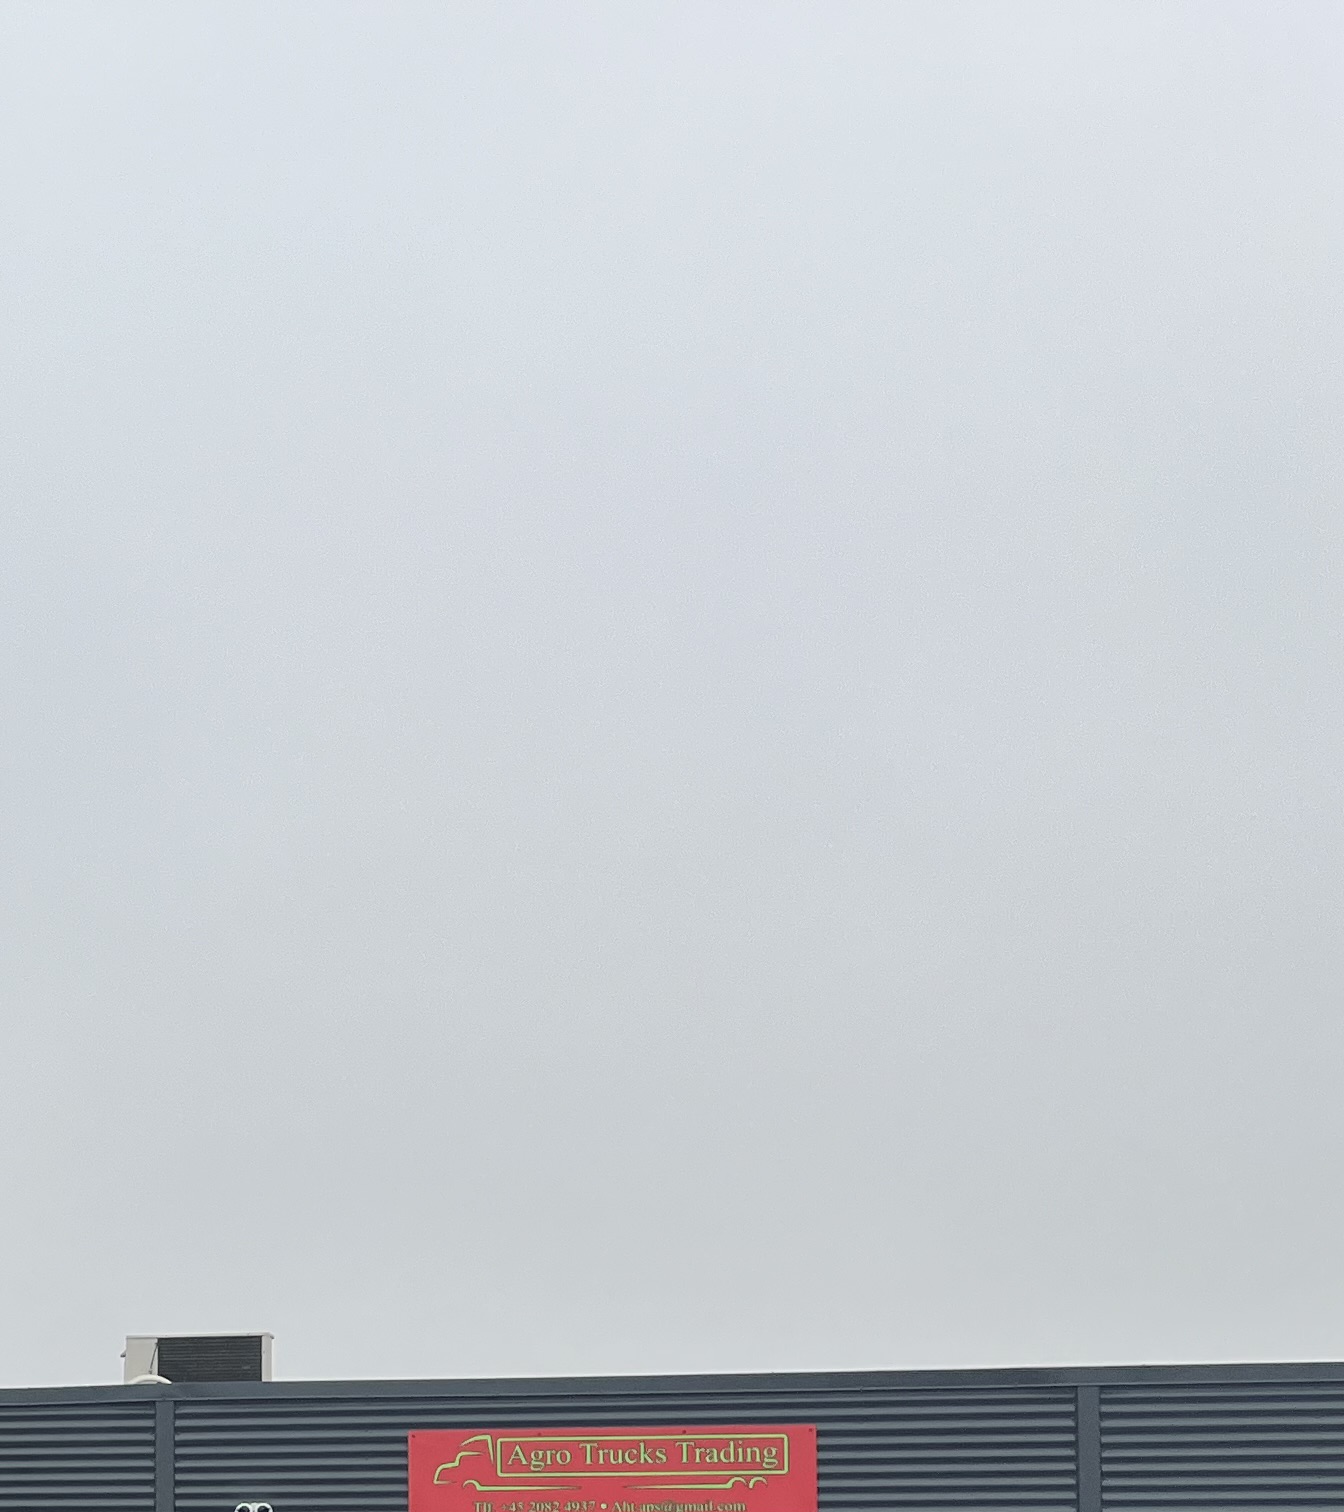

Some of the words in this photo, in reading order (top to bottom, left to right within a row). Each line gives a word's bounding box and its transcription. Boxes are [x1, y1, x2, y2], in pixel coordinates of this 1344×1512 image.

[507, 1444, 572, 1472] Agro
[579, 1441, 668, 1466] Trucks
[675, 1440, 779, 1469] Trading
[563, 1500, 596, 1512] 4937
